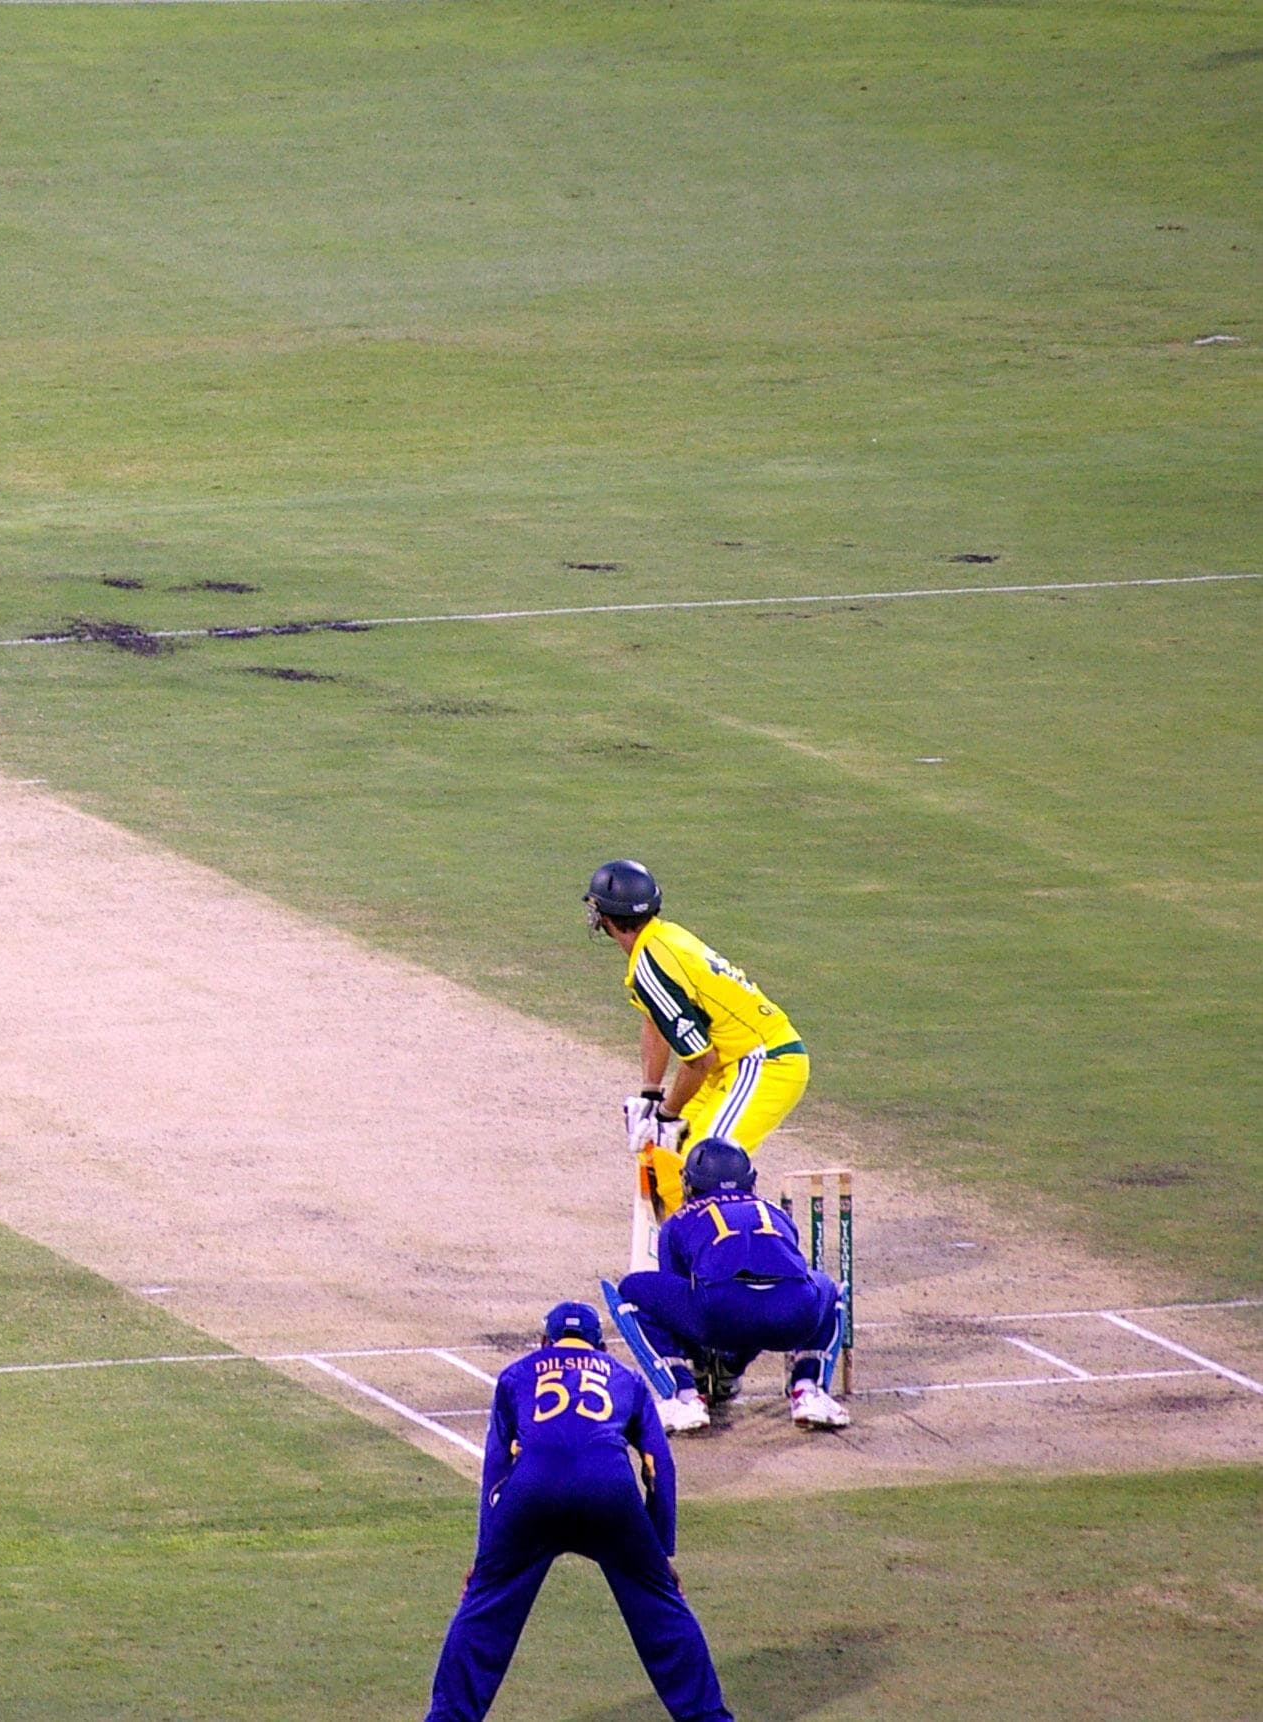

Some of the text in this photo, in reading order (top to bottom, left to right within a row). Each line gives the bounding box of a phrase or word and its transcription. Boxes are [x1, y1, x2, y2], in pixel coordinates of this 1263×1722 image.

[697, 1199, 783, 1246] 11
[534, 1355, 611, 1377] DILSHAN
[533, 1369, 614, 1423] 55
